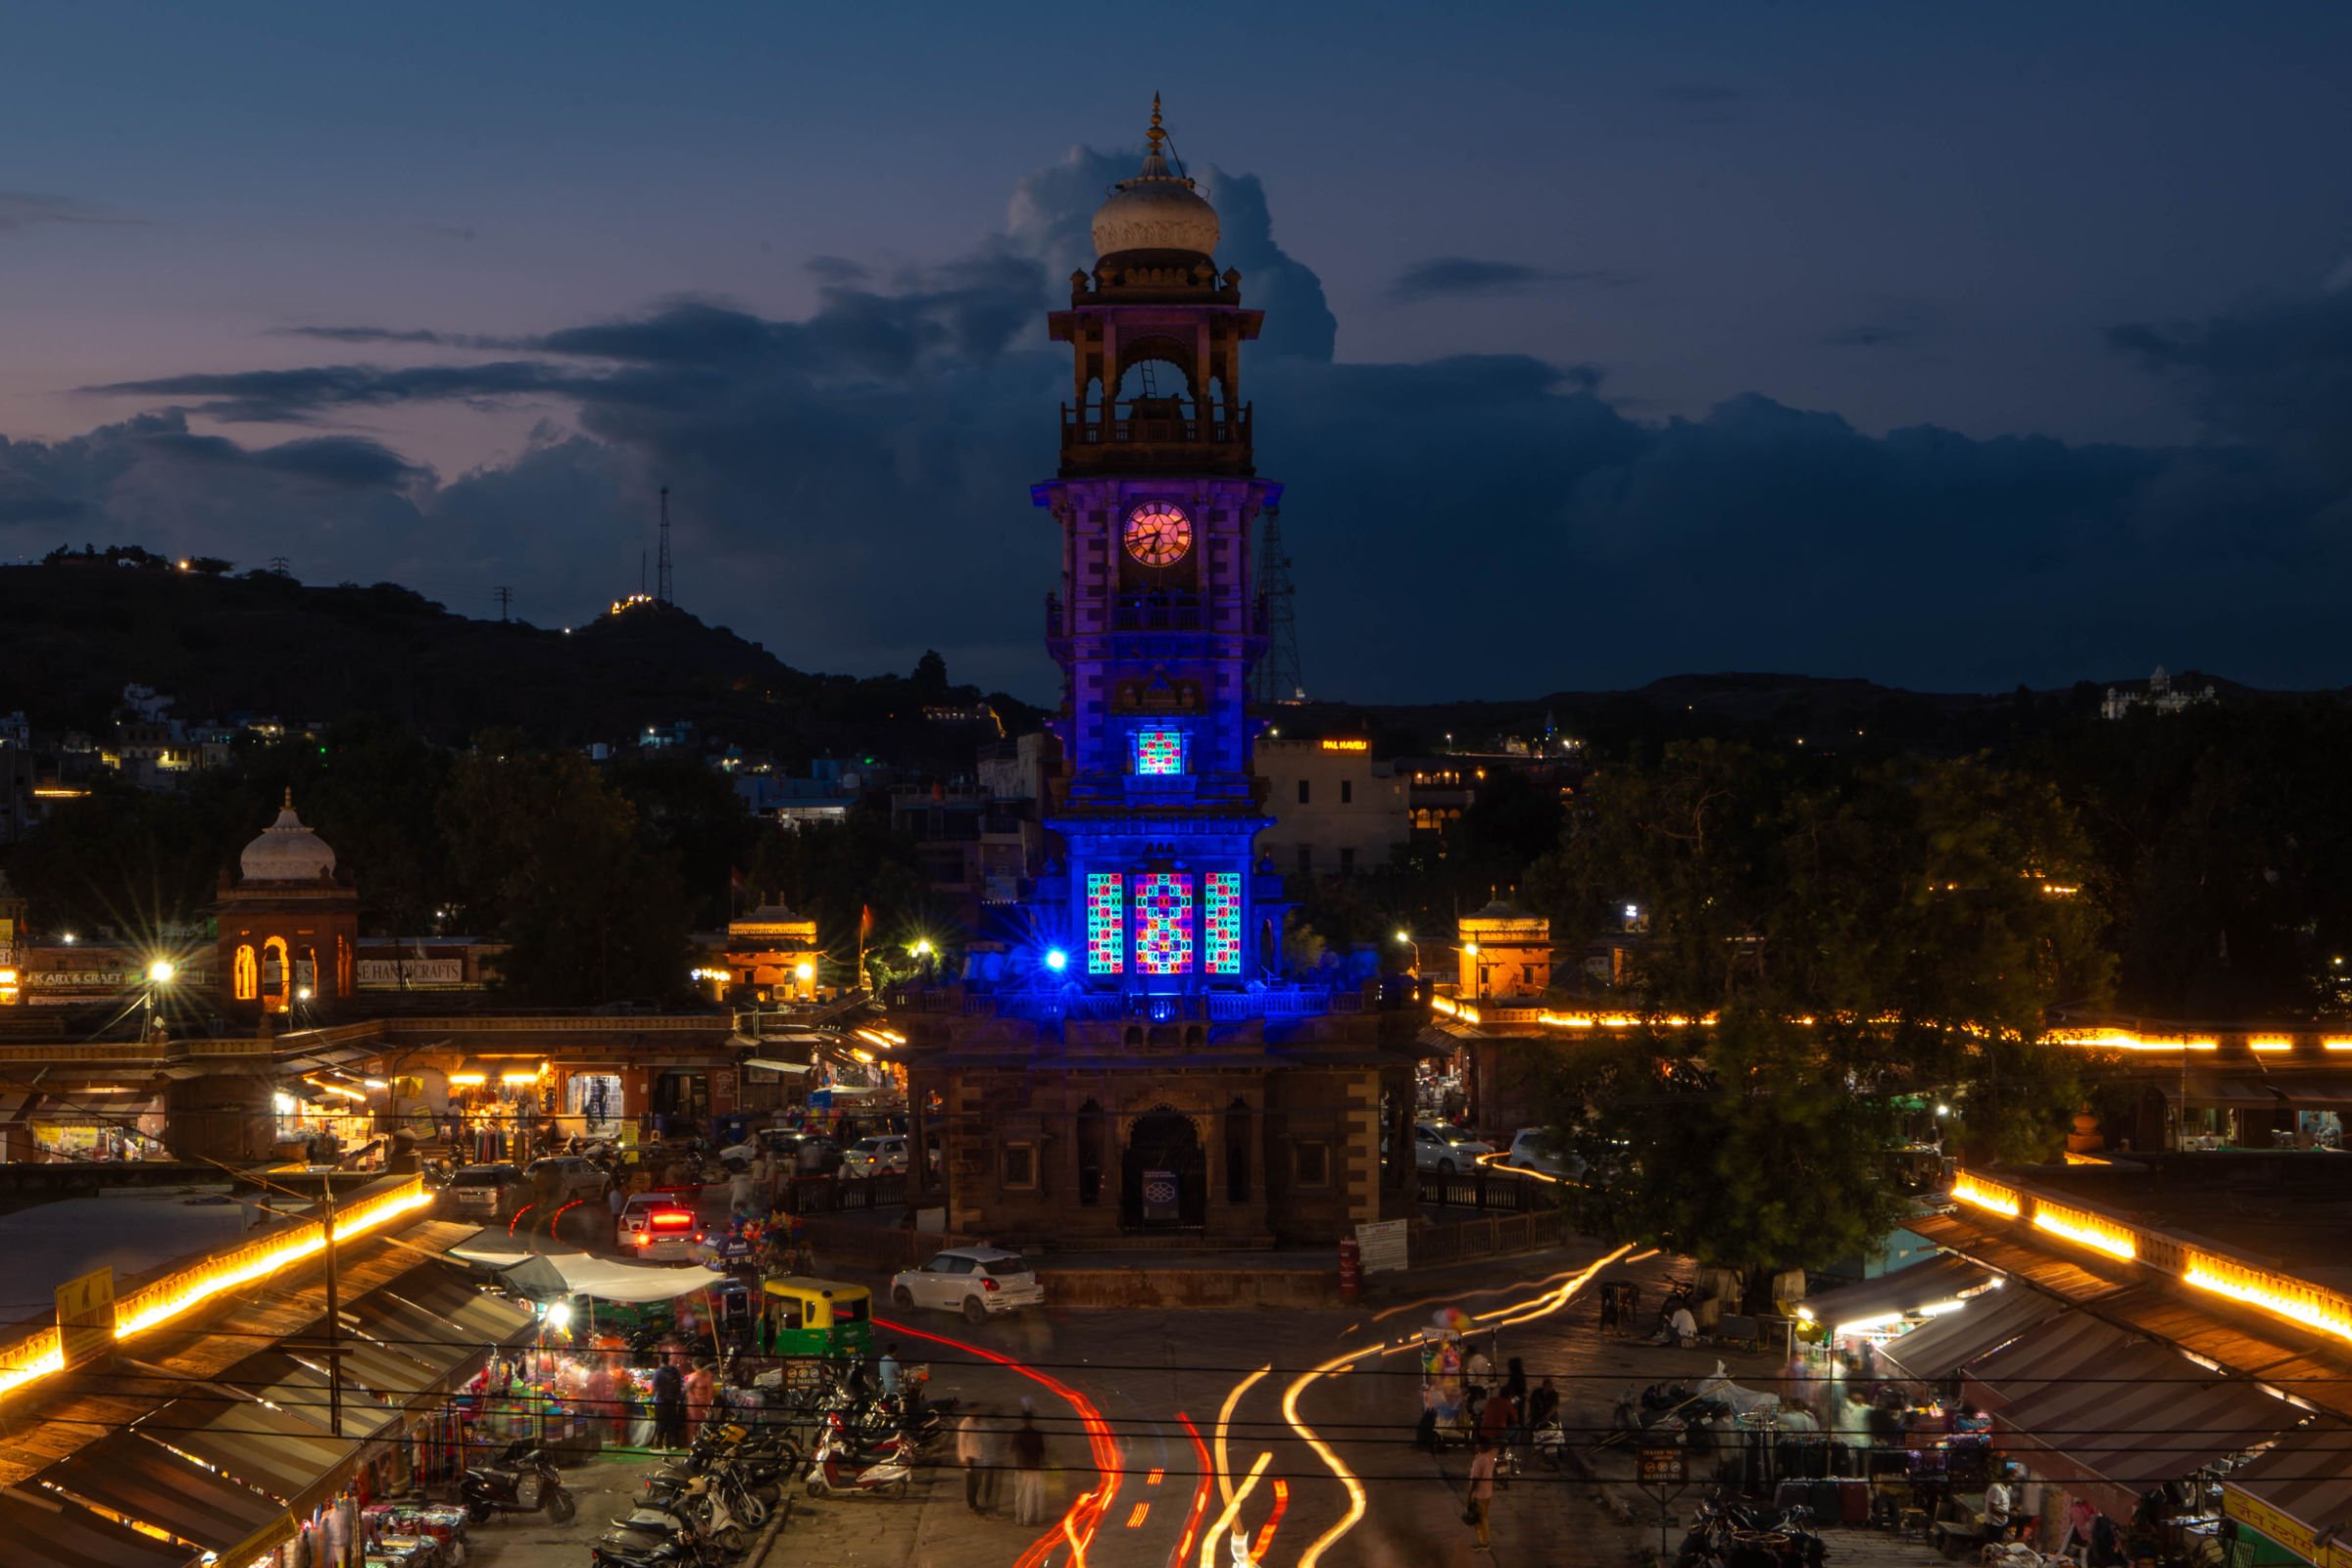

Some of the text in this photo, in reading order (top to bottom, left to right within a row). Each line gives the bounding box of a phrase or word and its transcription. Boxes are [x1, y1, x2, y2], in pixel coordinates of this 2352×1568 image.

[1323, 740, 1367, 750] PAL HAVELI
[45, 973, 72, 983] ART
[72, 973, 80, 983] &
[83, 973, 122, 982] CRAFT
